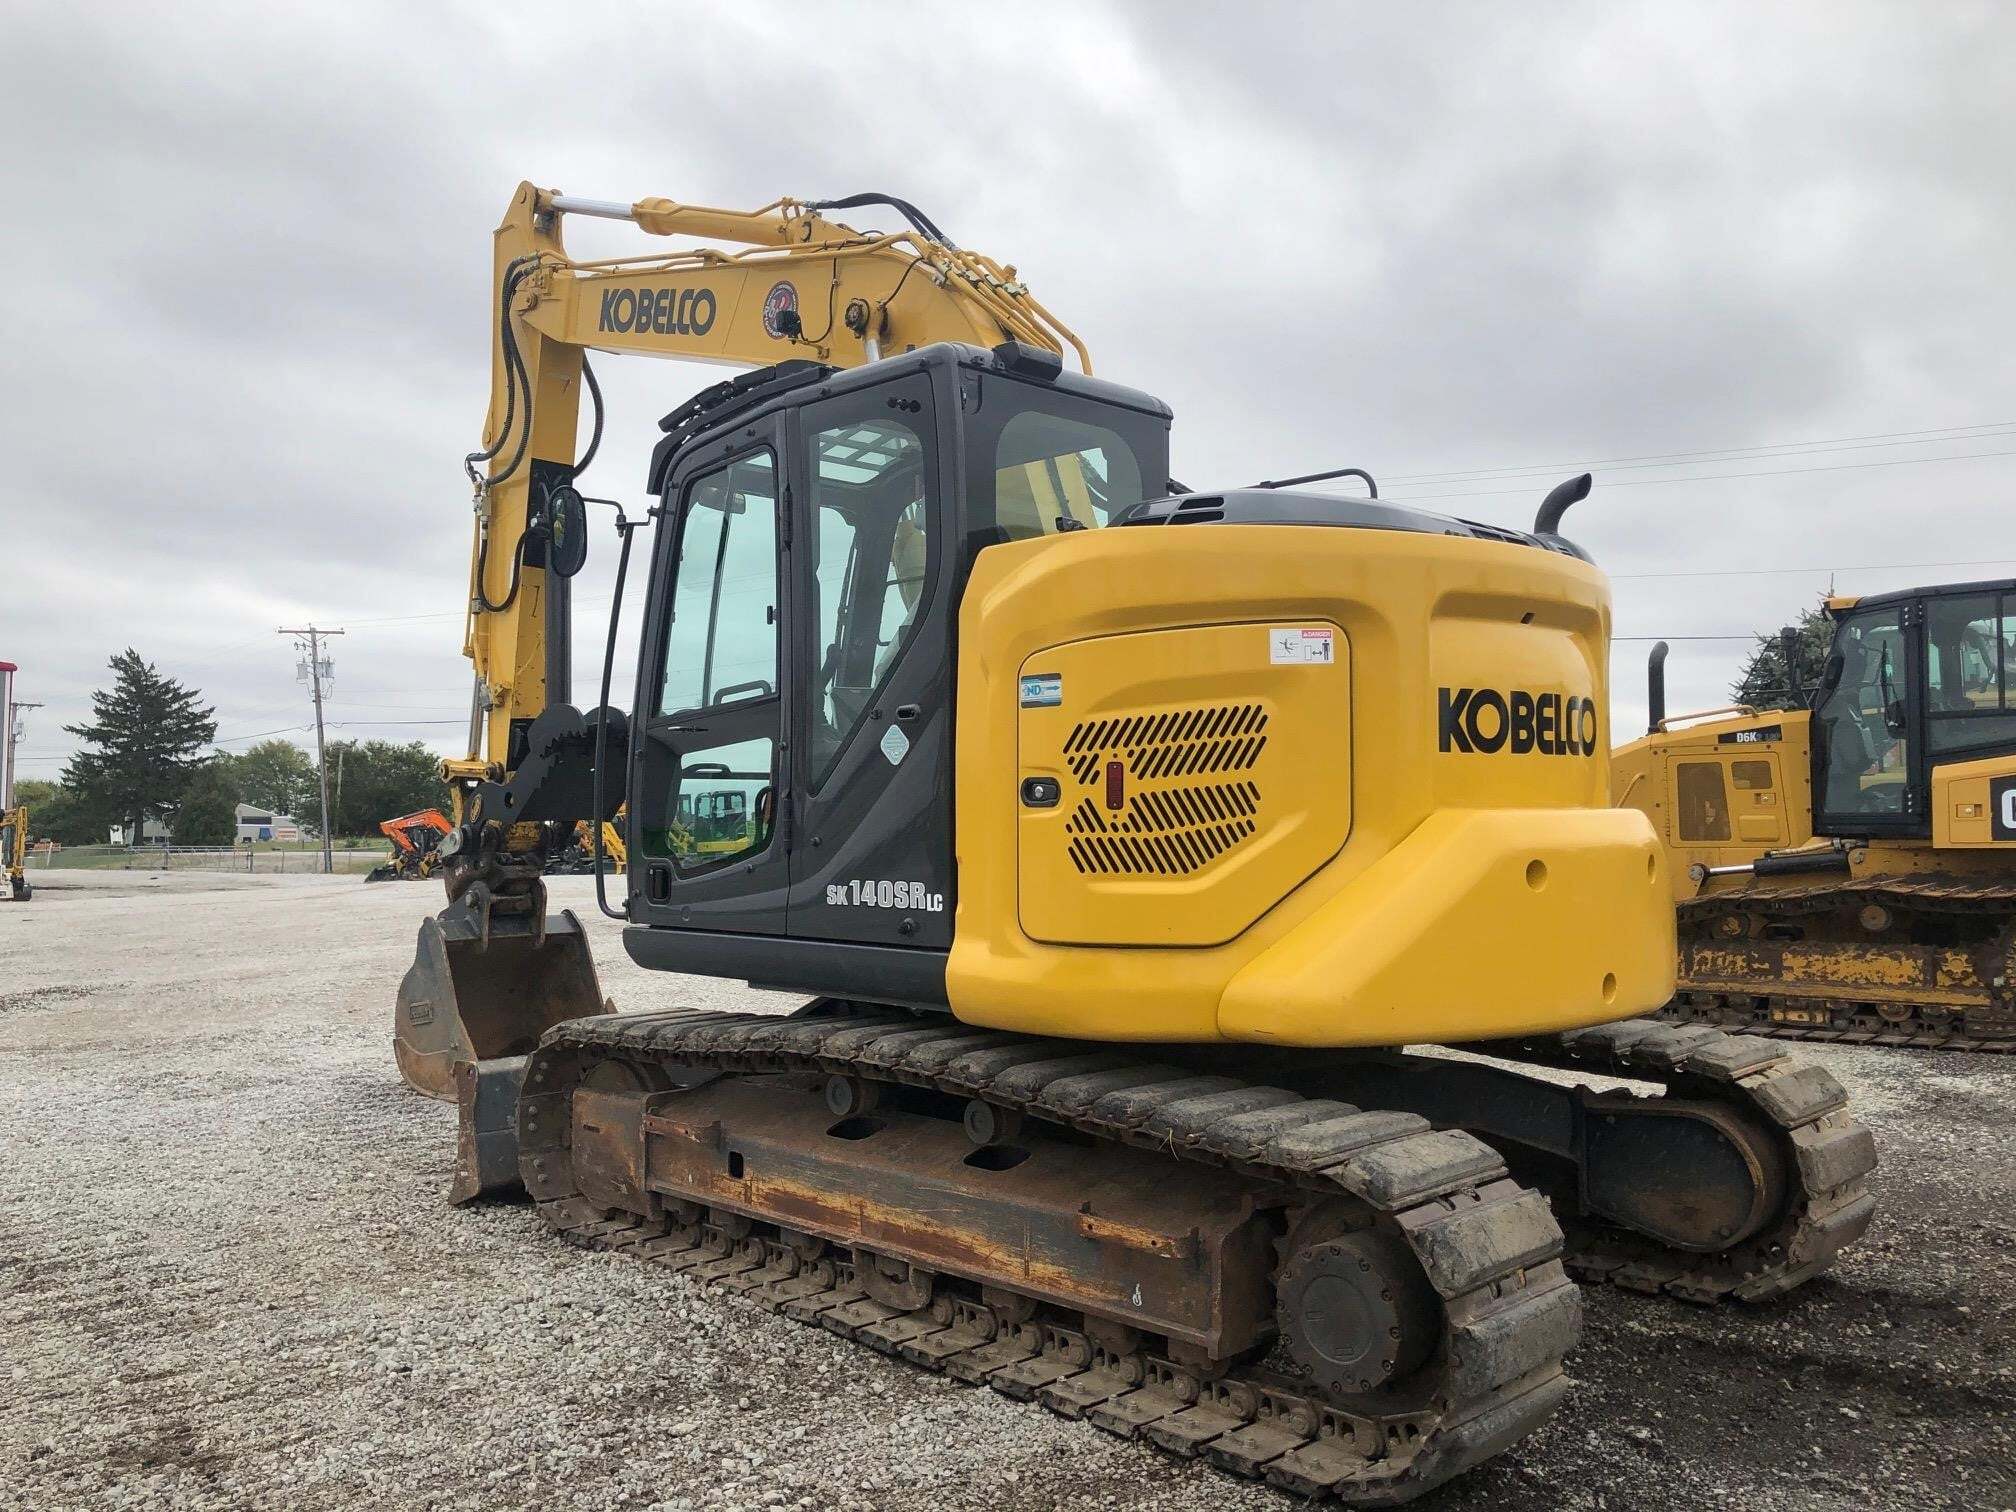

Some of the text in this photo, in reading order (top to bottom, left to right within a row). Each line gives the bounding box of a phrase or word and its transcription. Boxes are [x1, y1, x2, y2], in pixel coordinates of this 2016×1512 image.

[599, 288, 717, 336] KOBELCO
[1438, 687, 1597, 757] KOBELCO
[1736, 731, 1757, 743] D6K
